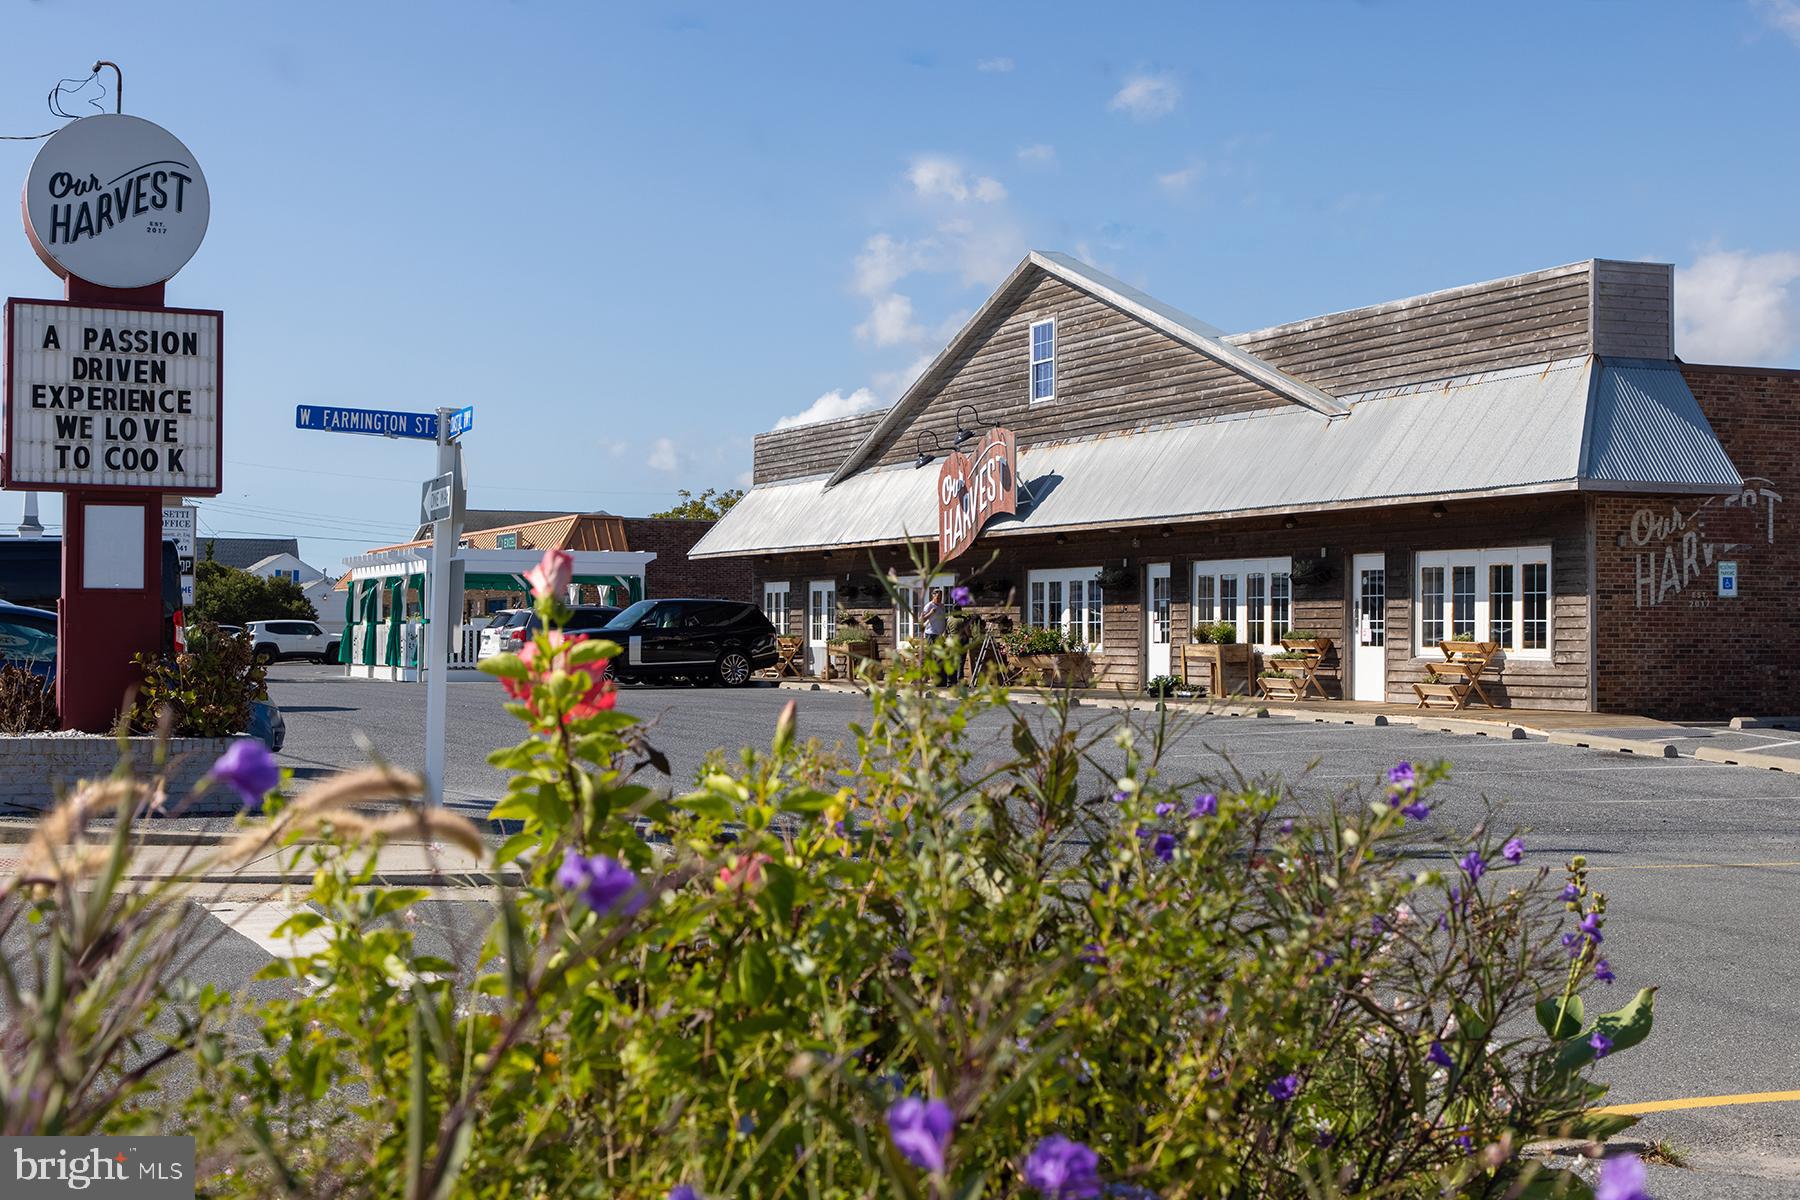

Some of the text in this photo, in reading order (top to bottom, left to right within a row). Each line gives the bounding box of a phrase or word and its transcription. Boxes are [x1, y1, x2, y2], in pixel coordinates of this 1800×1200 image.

[49, 172, 102, 199] Our
[49, 170, 192, 245] HARVEST
[43, 325, 197, 355] A PASSION
[73, 357, 166, 383] DRIVEN
[32, 385, 191, 414] EXPERIENCE
[56, 416, 178, 442] WE LOVE
[300, 408, 315, 426] W.
[323, 410, 407, 432] FARMINGTON
[415, 417, 434, 434] ST.
[55, 446, 90, 469] TO
[942, 470, 965, 506] Our
[162, 510, 189, 518] SETTI
[944, 455, 1007, 553] HARVEST
[1630, 505, 1686, 546] Our
